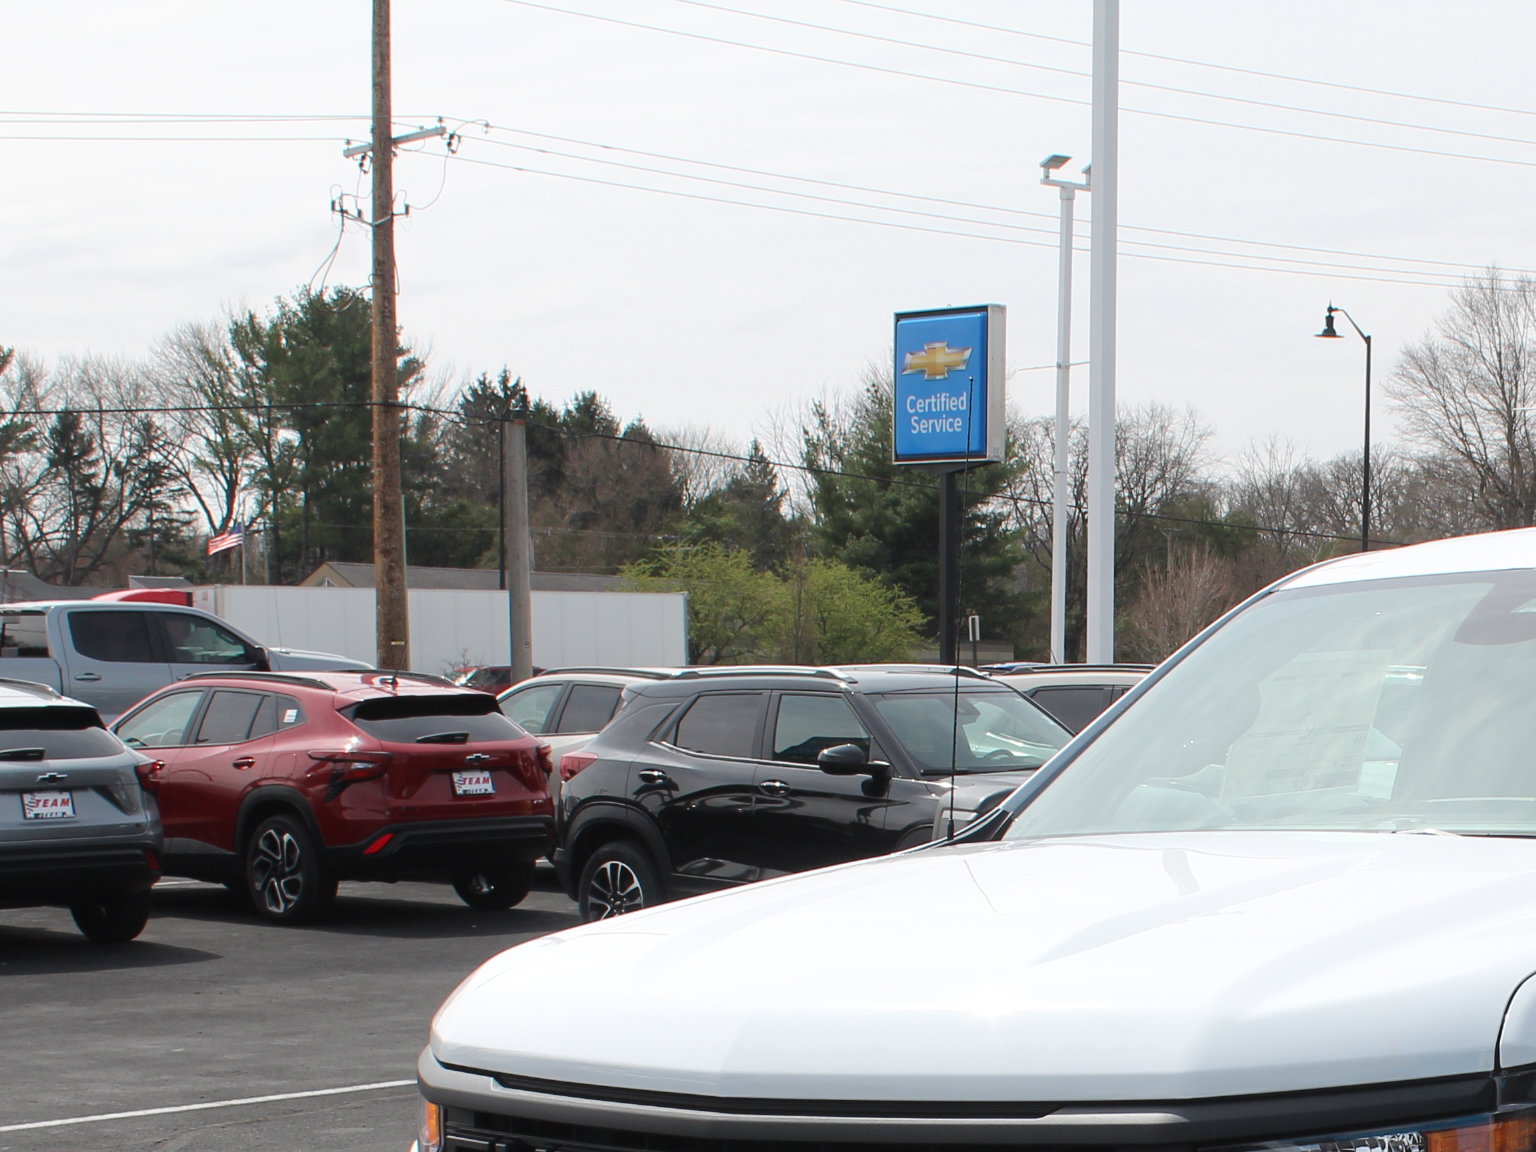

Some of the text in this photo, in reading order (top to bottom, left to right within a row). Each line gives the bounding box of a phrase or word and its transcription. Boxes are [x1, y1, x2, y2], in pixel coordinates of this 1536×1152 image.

[906, 392, 967, 413] Certified
[911, 415, 963, 433] Service
[462, 776, 490, 786] TEAM
[35, 798, 70, 808] TEAM
